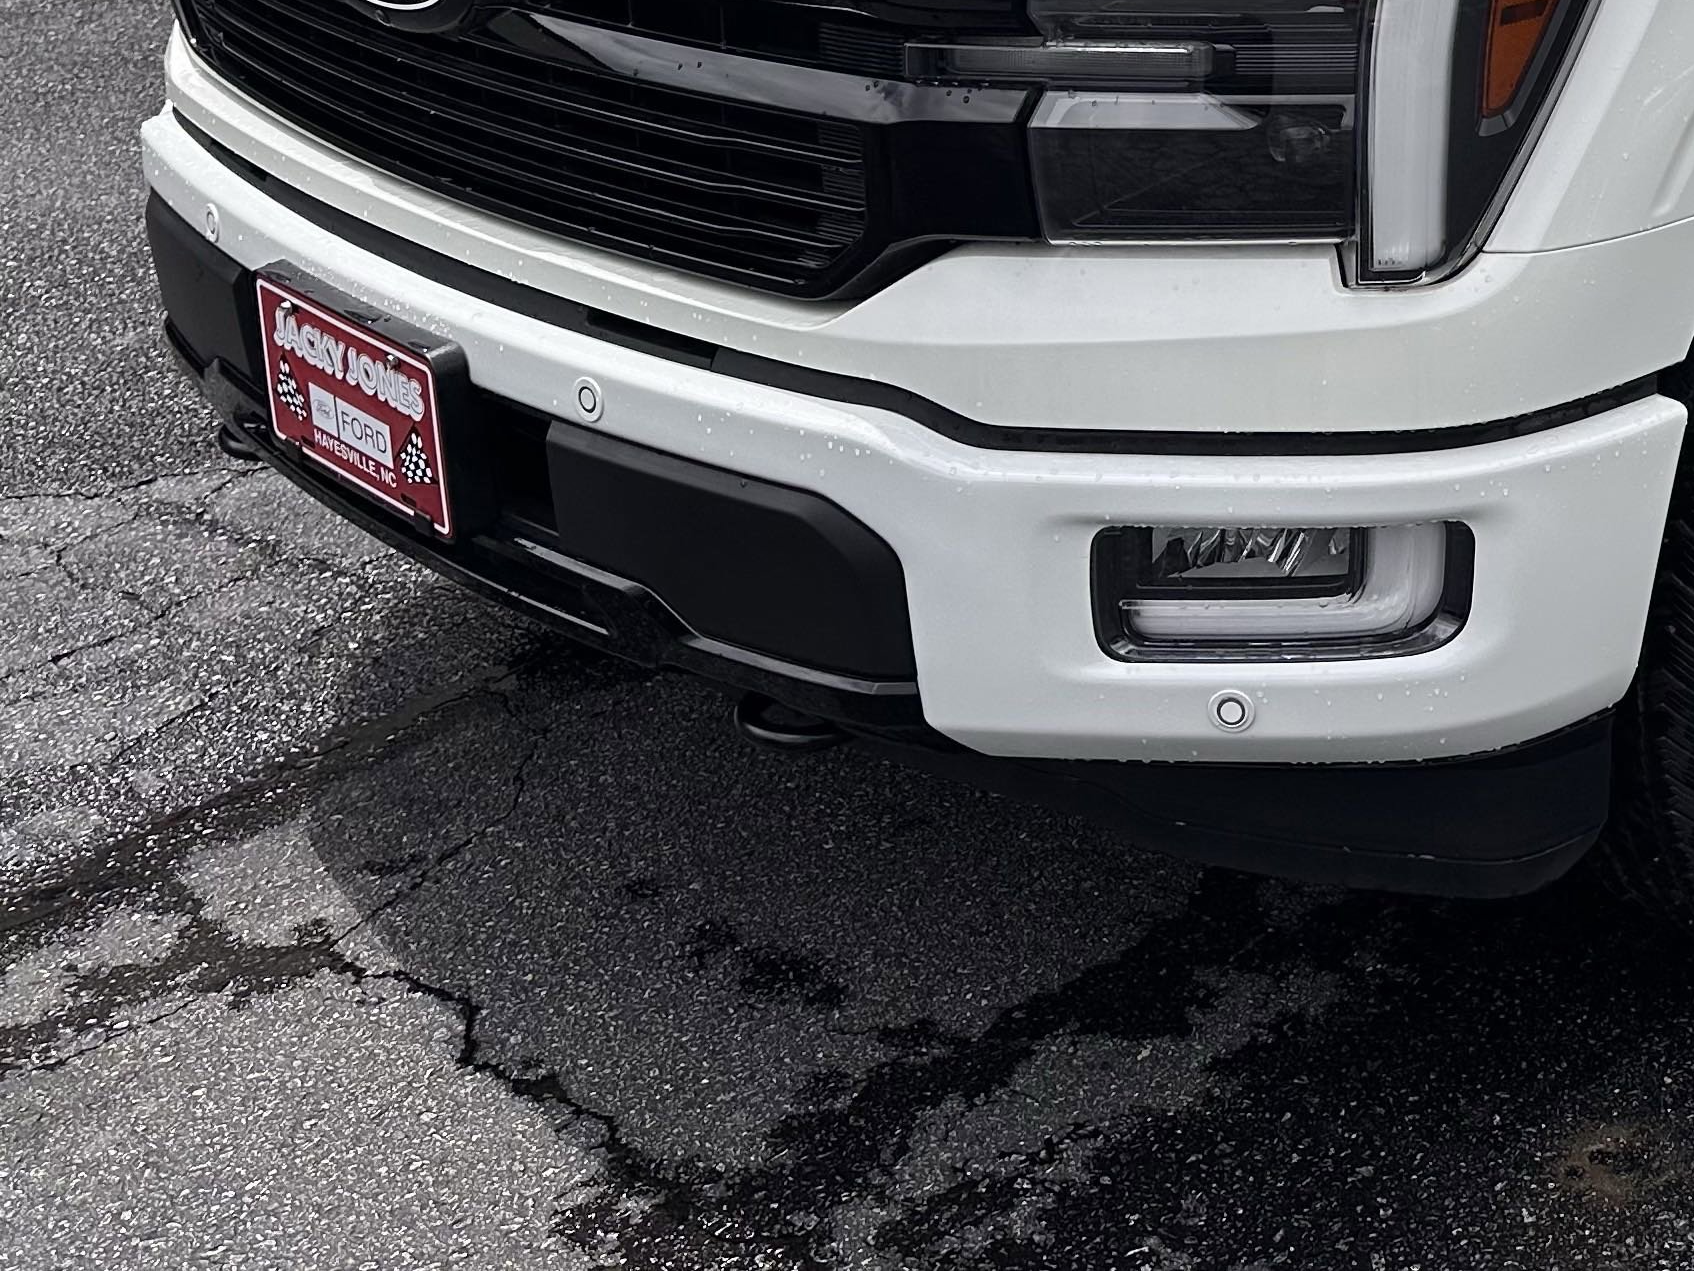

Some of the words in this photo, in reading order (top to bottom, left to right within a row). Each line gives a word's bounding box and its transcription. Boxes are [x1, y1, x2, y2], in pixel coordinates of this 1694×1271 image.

[273, 306, 346, 380] JACKY
[346, 347, 425, 422] JONES
[313, 428, 380, 481] HAYESVILLE,
[381, 468, 398, 489] NC
[341, 410, 387, 454] FORD
